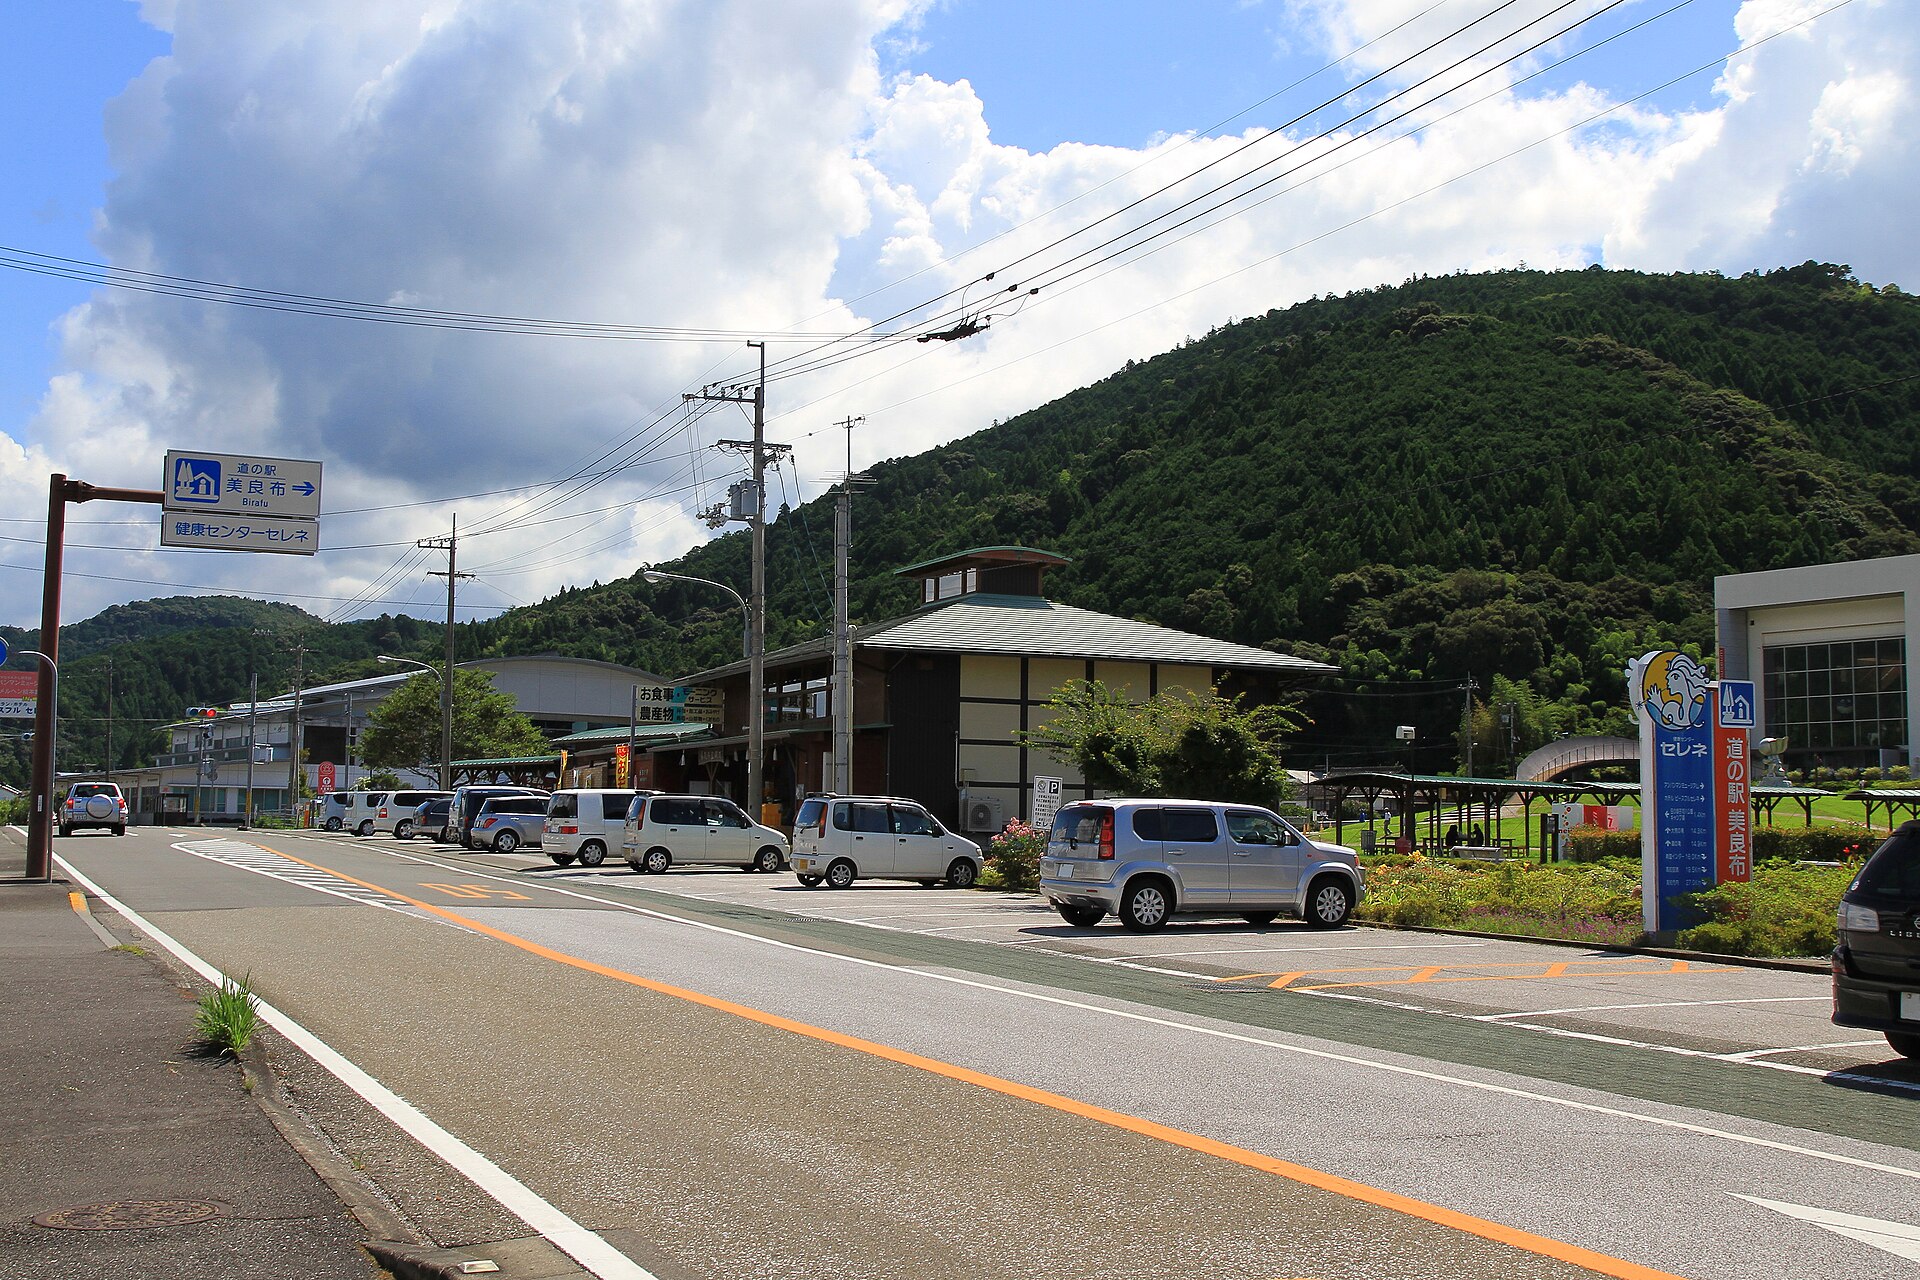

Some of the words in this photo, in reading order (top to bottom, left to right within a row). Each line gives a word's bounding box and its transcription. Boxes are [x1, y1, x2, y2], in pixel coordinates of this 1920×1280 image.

[237, 462, 277, 476] 道の駅
[225, 477, 286, 497] 美良布
[242, 497, 269, 508] Birafu
[175, 521, 309, 543] 健康センターセレネ
[688, 696, 712, 704] サービス
[640, 706, 674, 722] 農産物
[1660, 741, 1708, 757] セレネ
[1726, 737, 1746, 804] 道の駅
[1050, 782, 1058, 793] P
[1728, 809, 1746, 877] 美良布
